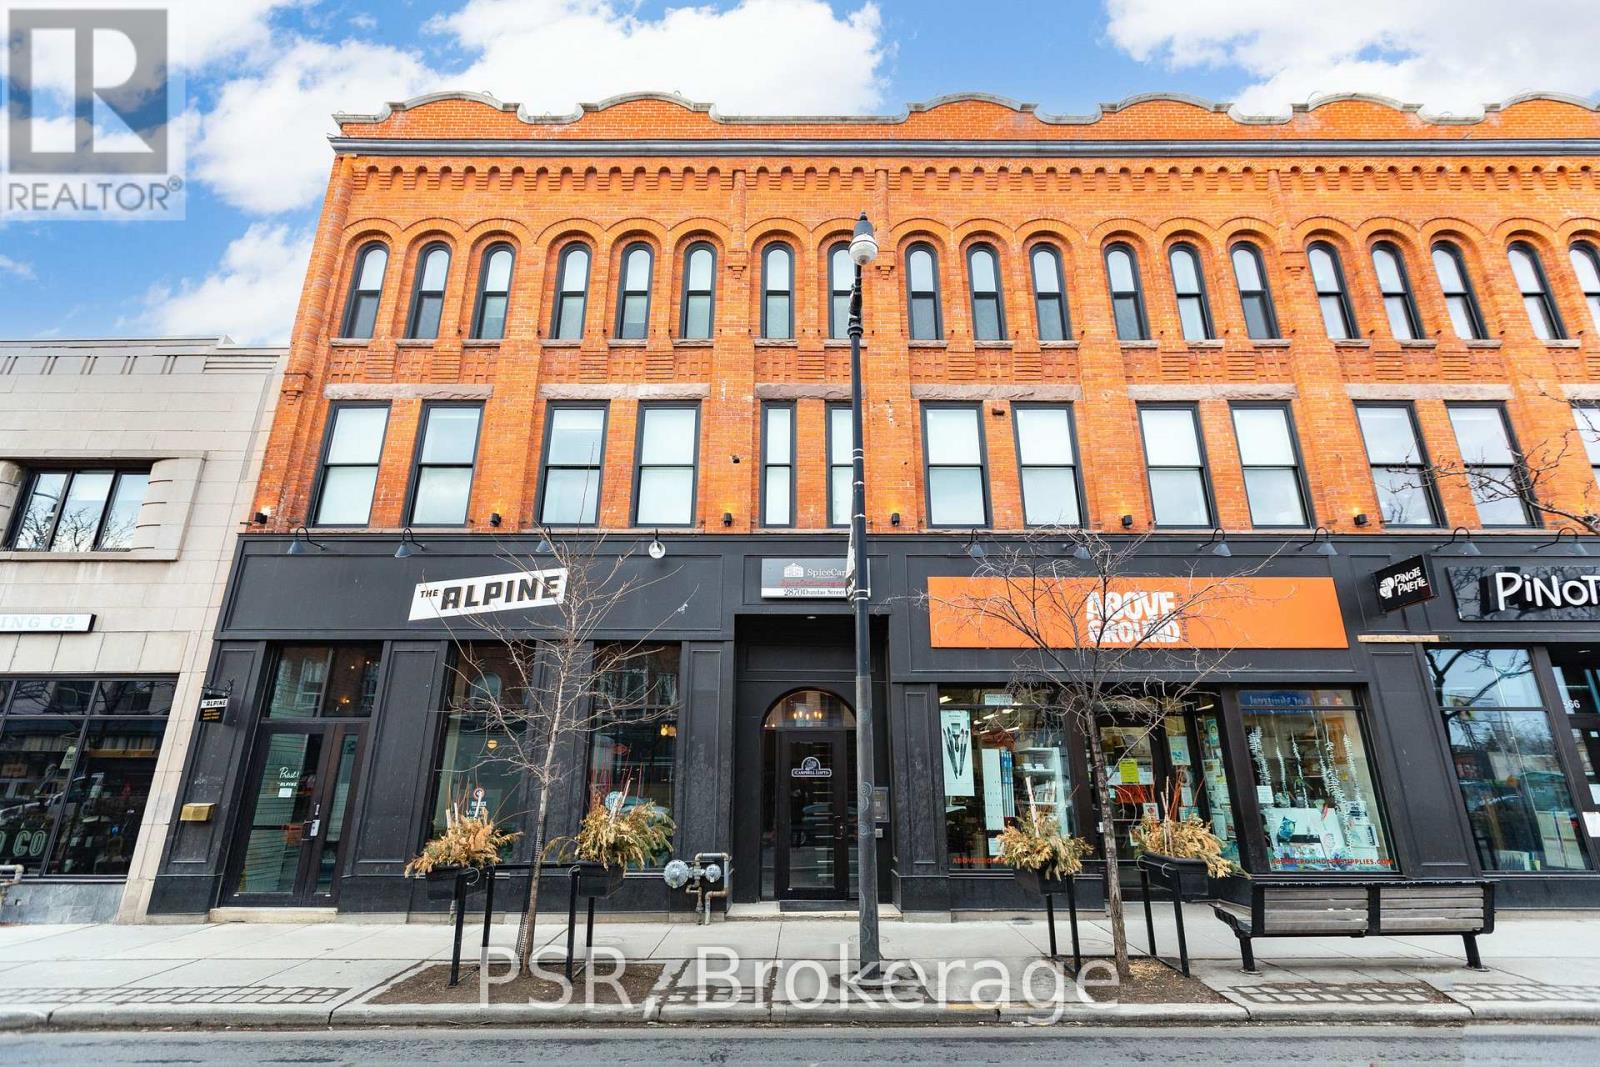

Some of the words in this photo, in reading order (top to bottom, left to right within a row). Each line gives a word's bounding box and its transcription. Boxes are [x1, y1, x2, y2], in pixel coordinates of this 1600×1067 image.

[420, 589, 439, 598] THE
[440, 575, 560, 610] ALPINE
[1398, 577, 1428, 596] PALETTE
[1086, 591, 1178, 621] ABOVE
[1087, 620, 1181, 643] GROUND
